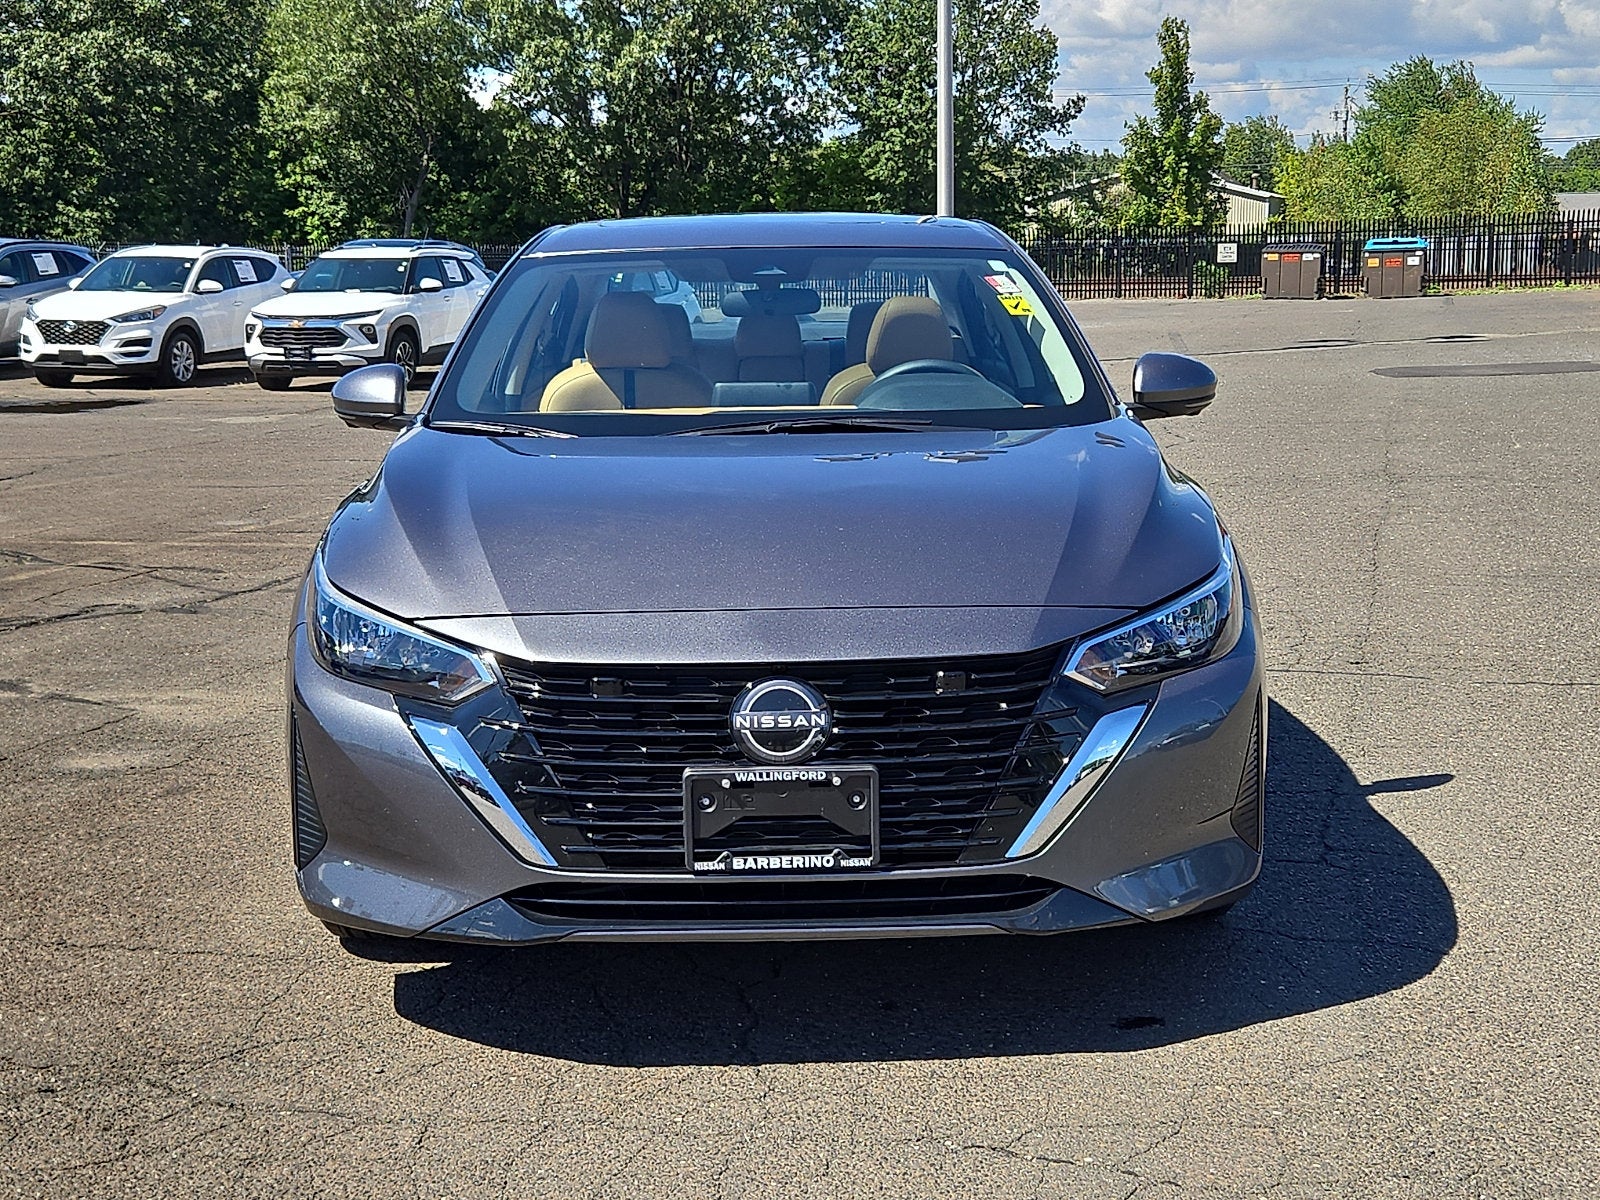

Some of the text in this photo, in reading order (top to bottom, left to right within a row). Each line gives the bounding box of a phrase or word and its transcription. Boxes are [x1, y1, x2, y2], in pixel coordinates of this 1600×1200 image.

[735, 713, 826, 729] NISSAN
[735, 771, 827, 782] WALLINGFORD
[694, 856, 872, 871] NISSAN BARBERINO NISSAN
